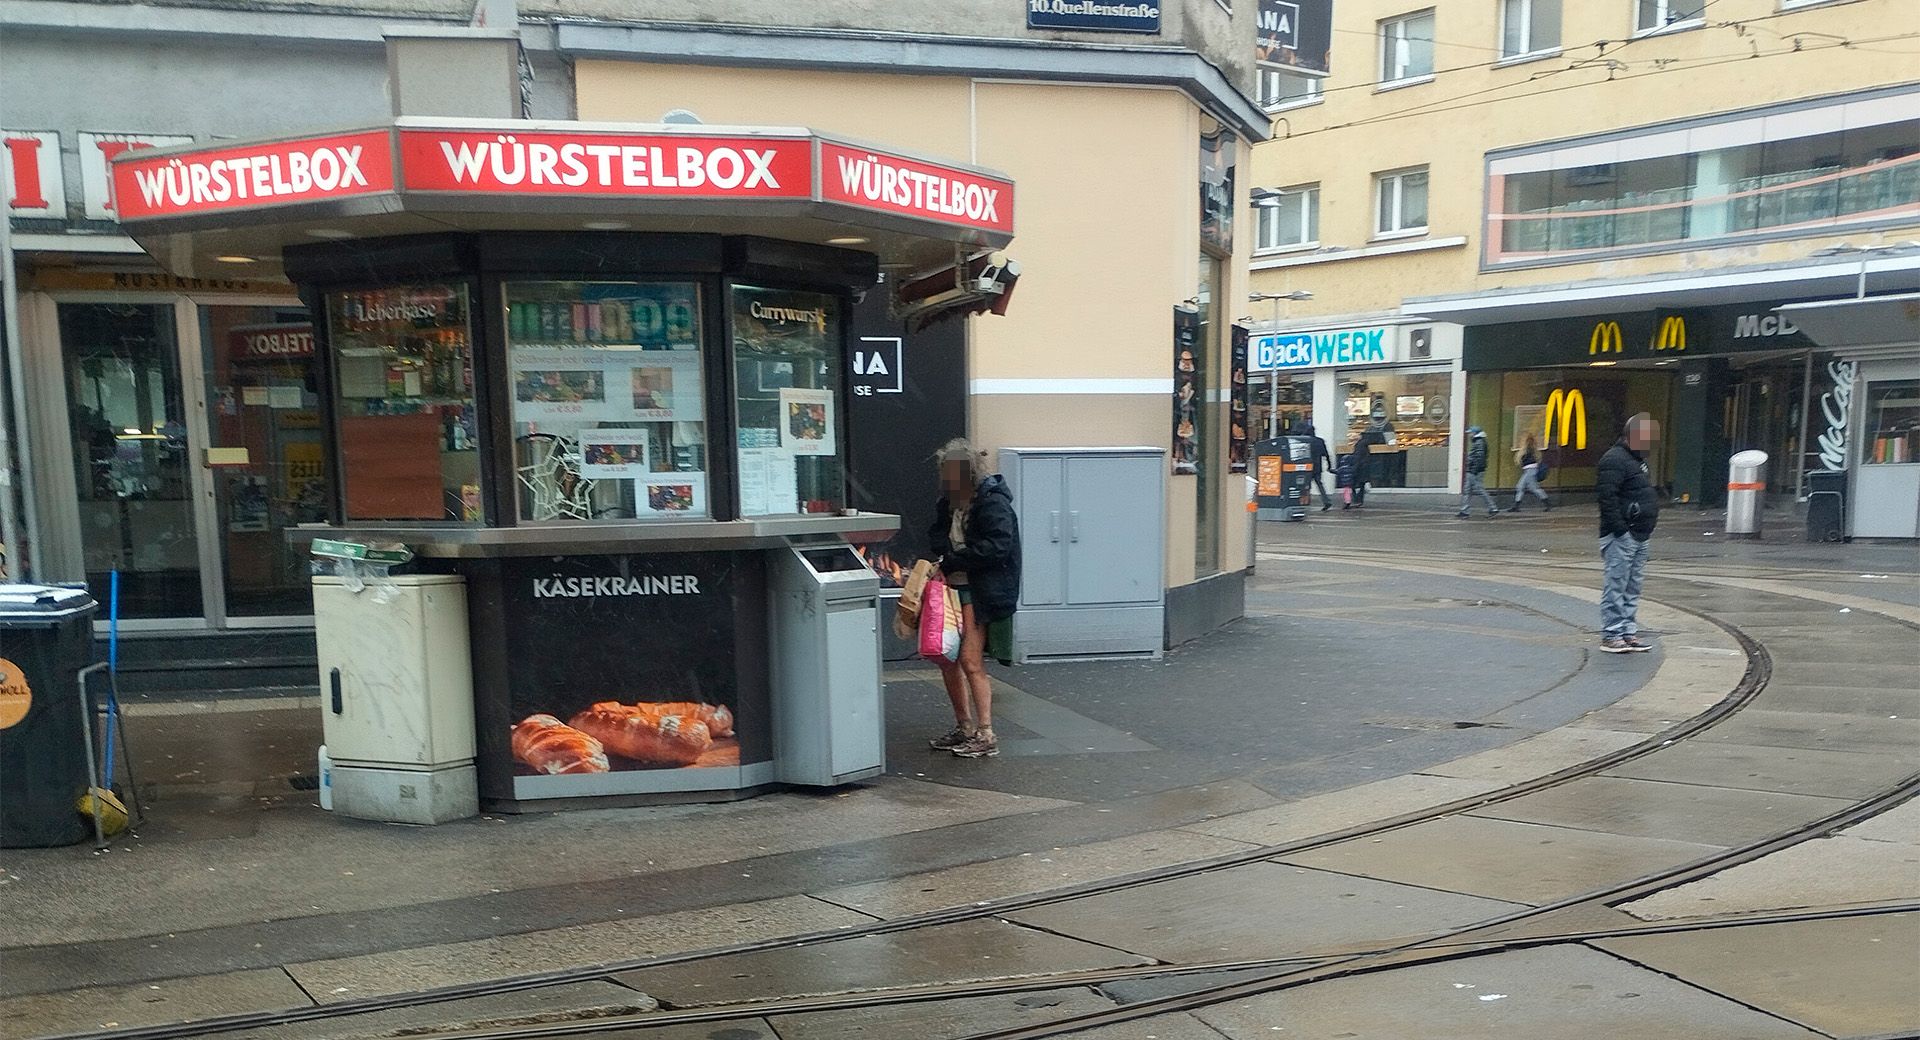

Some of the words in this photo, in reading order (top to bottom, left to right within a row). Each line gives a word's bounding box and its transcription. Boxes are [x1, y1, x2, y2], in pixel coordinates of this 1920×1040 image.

[135, 144, 368, 209] WÜRSTELBOX
[440, 135, 781, 189] WÜRSTELBOX
[838, 154, 999, 223] WÜRSTELBOX
[751, 301, 823, 325] Currywurst
[533, 573, 701, 598] KÄSEKRAINER
